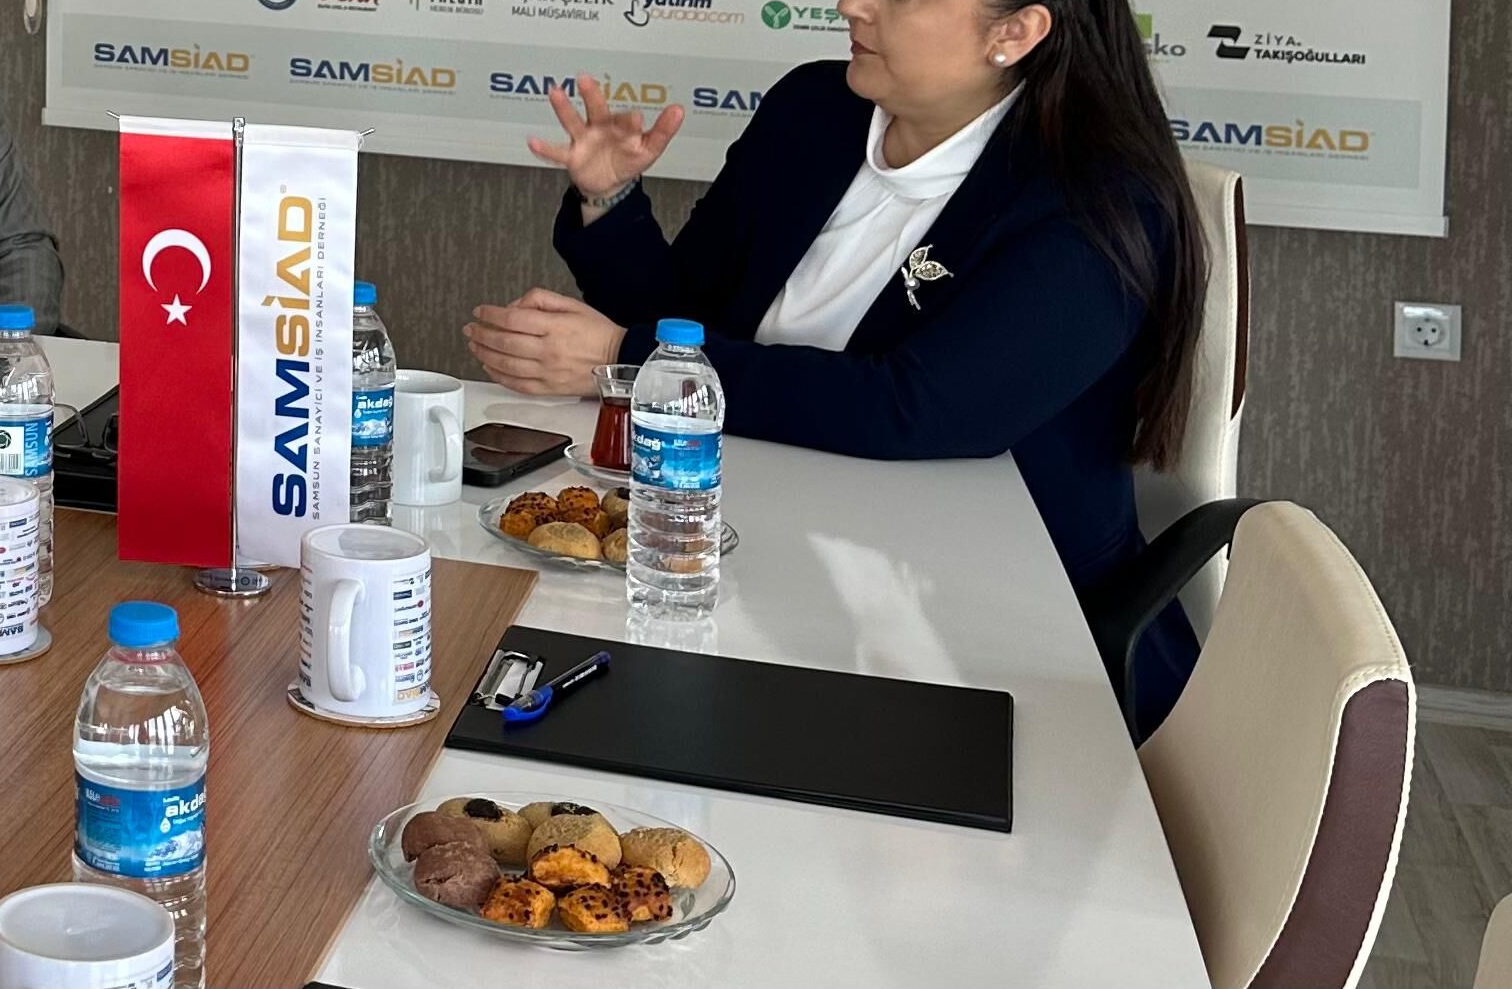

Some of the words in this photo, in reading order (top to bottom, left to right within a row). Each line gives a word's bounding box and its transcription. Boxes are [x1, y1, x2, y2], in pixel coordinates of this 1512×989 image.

[1254, 49, 1365, 64] TAKIŞOĞULLARI
[490, 73, 666, 107] SAMİAD
[315, 365, 323, 383] VE
[24, 422, 38, 477] SAMSUN
